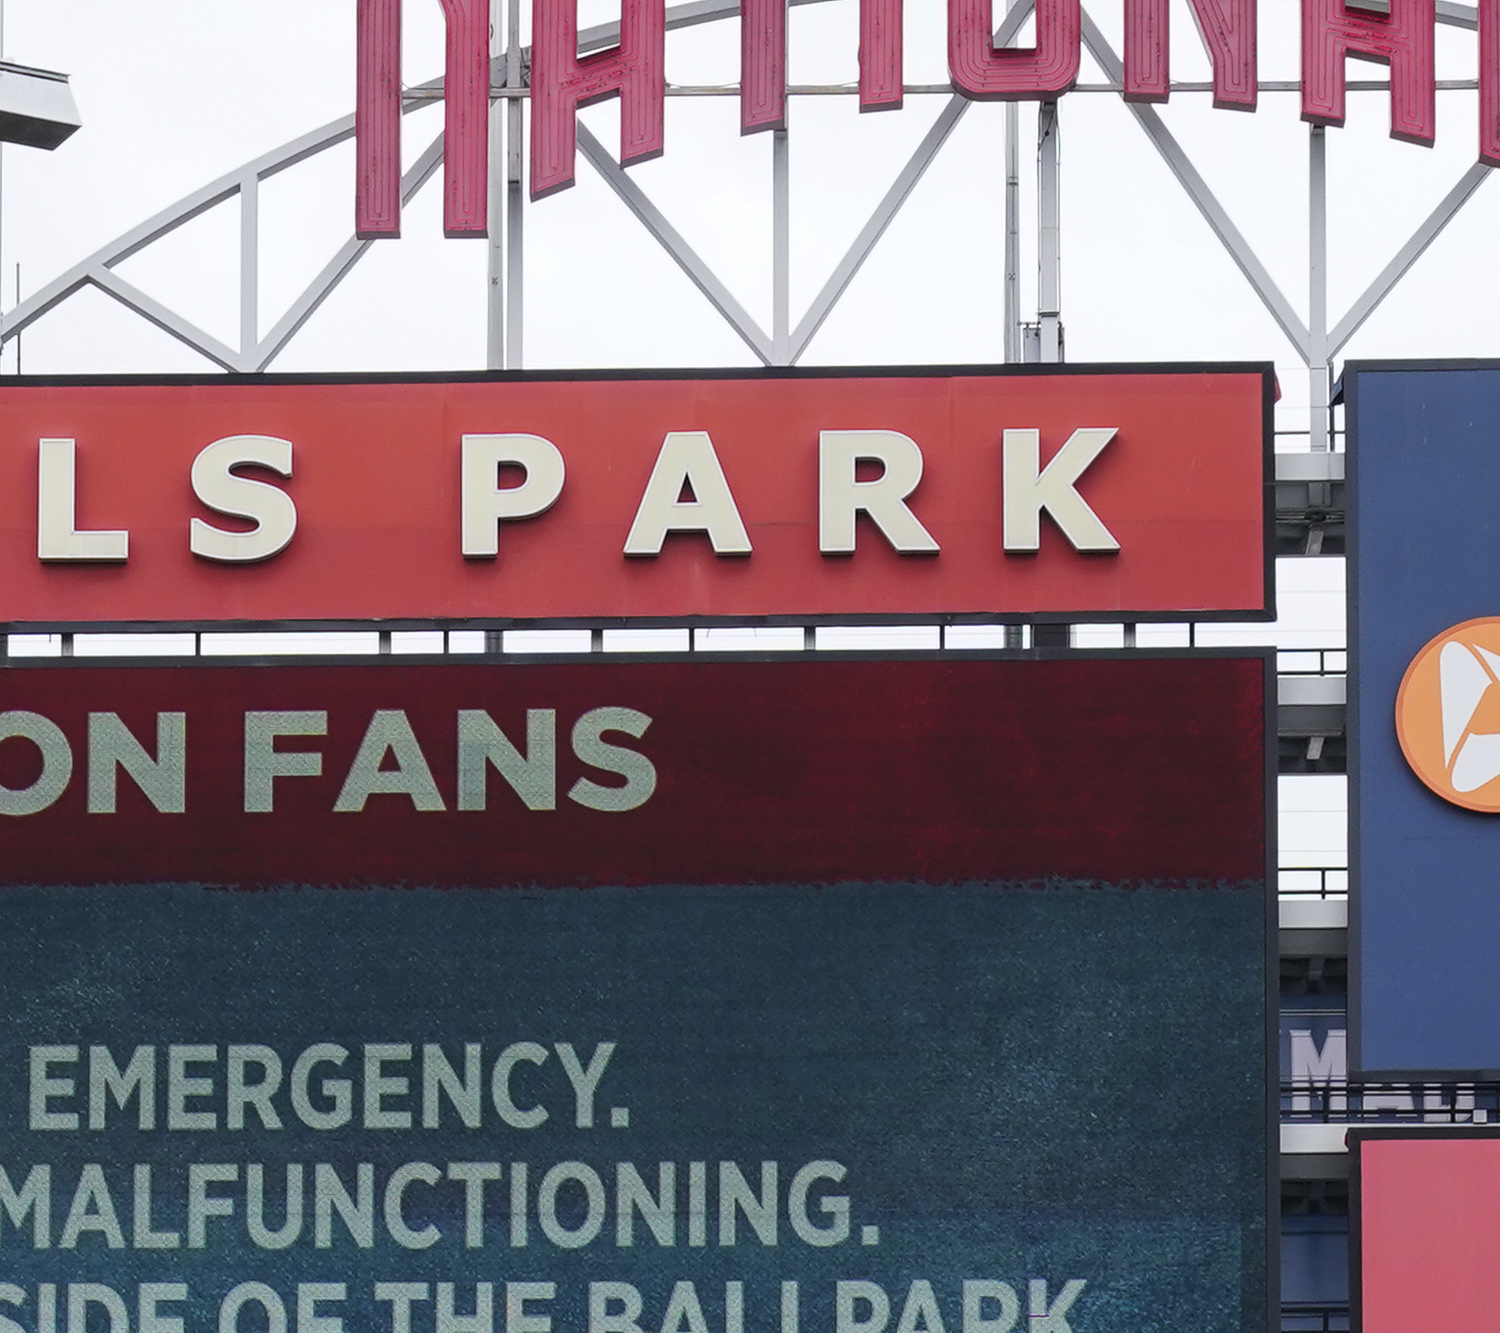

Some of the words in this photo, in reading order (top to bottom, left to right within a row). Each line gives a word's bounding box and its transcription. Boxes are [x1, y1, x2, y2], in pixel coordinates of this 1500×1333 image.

[457, 425, 1123, 564] PARK
[244, 706, 659, 814] FANS
[28, 1040, 630, 1130] EMERGENCY.
